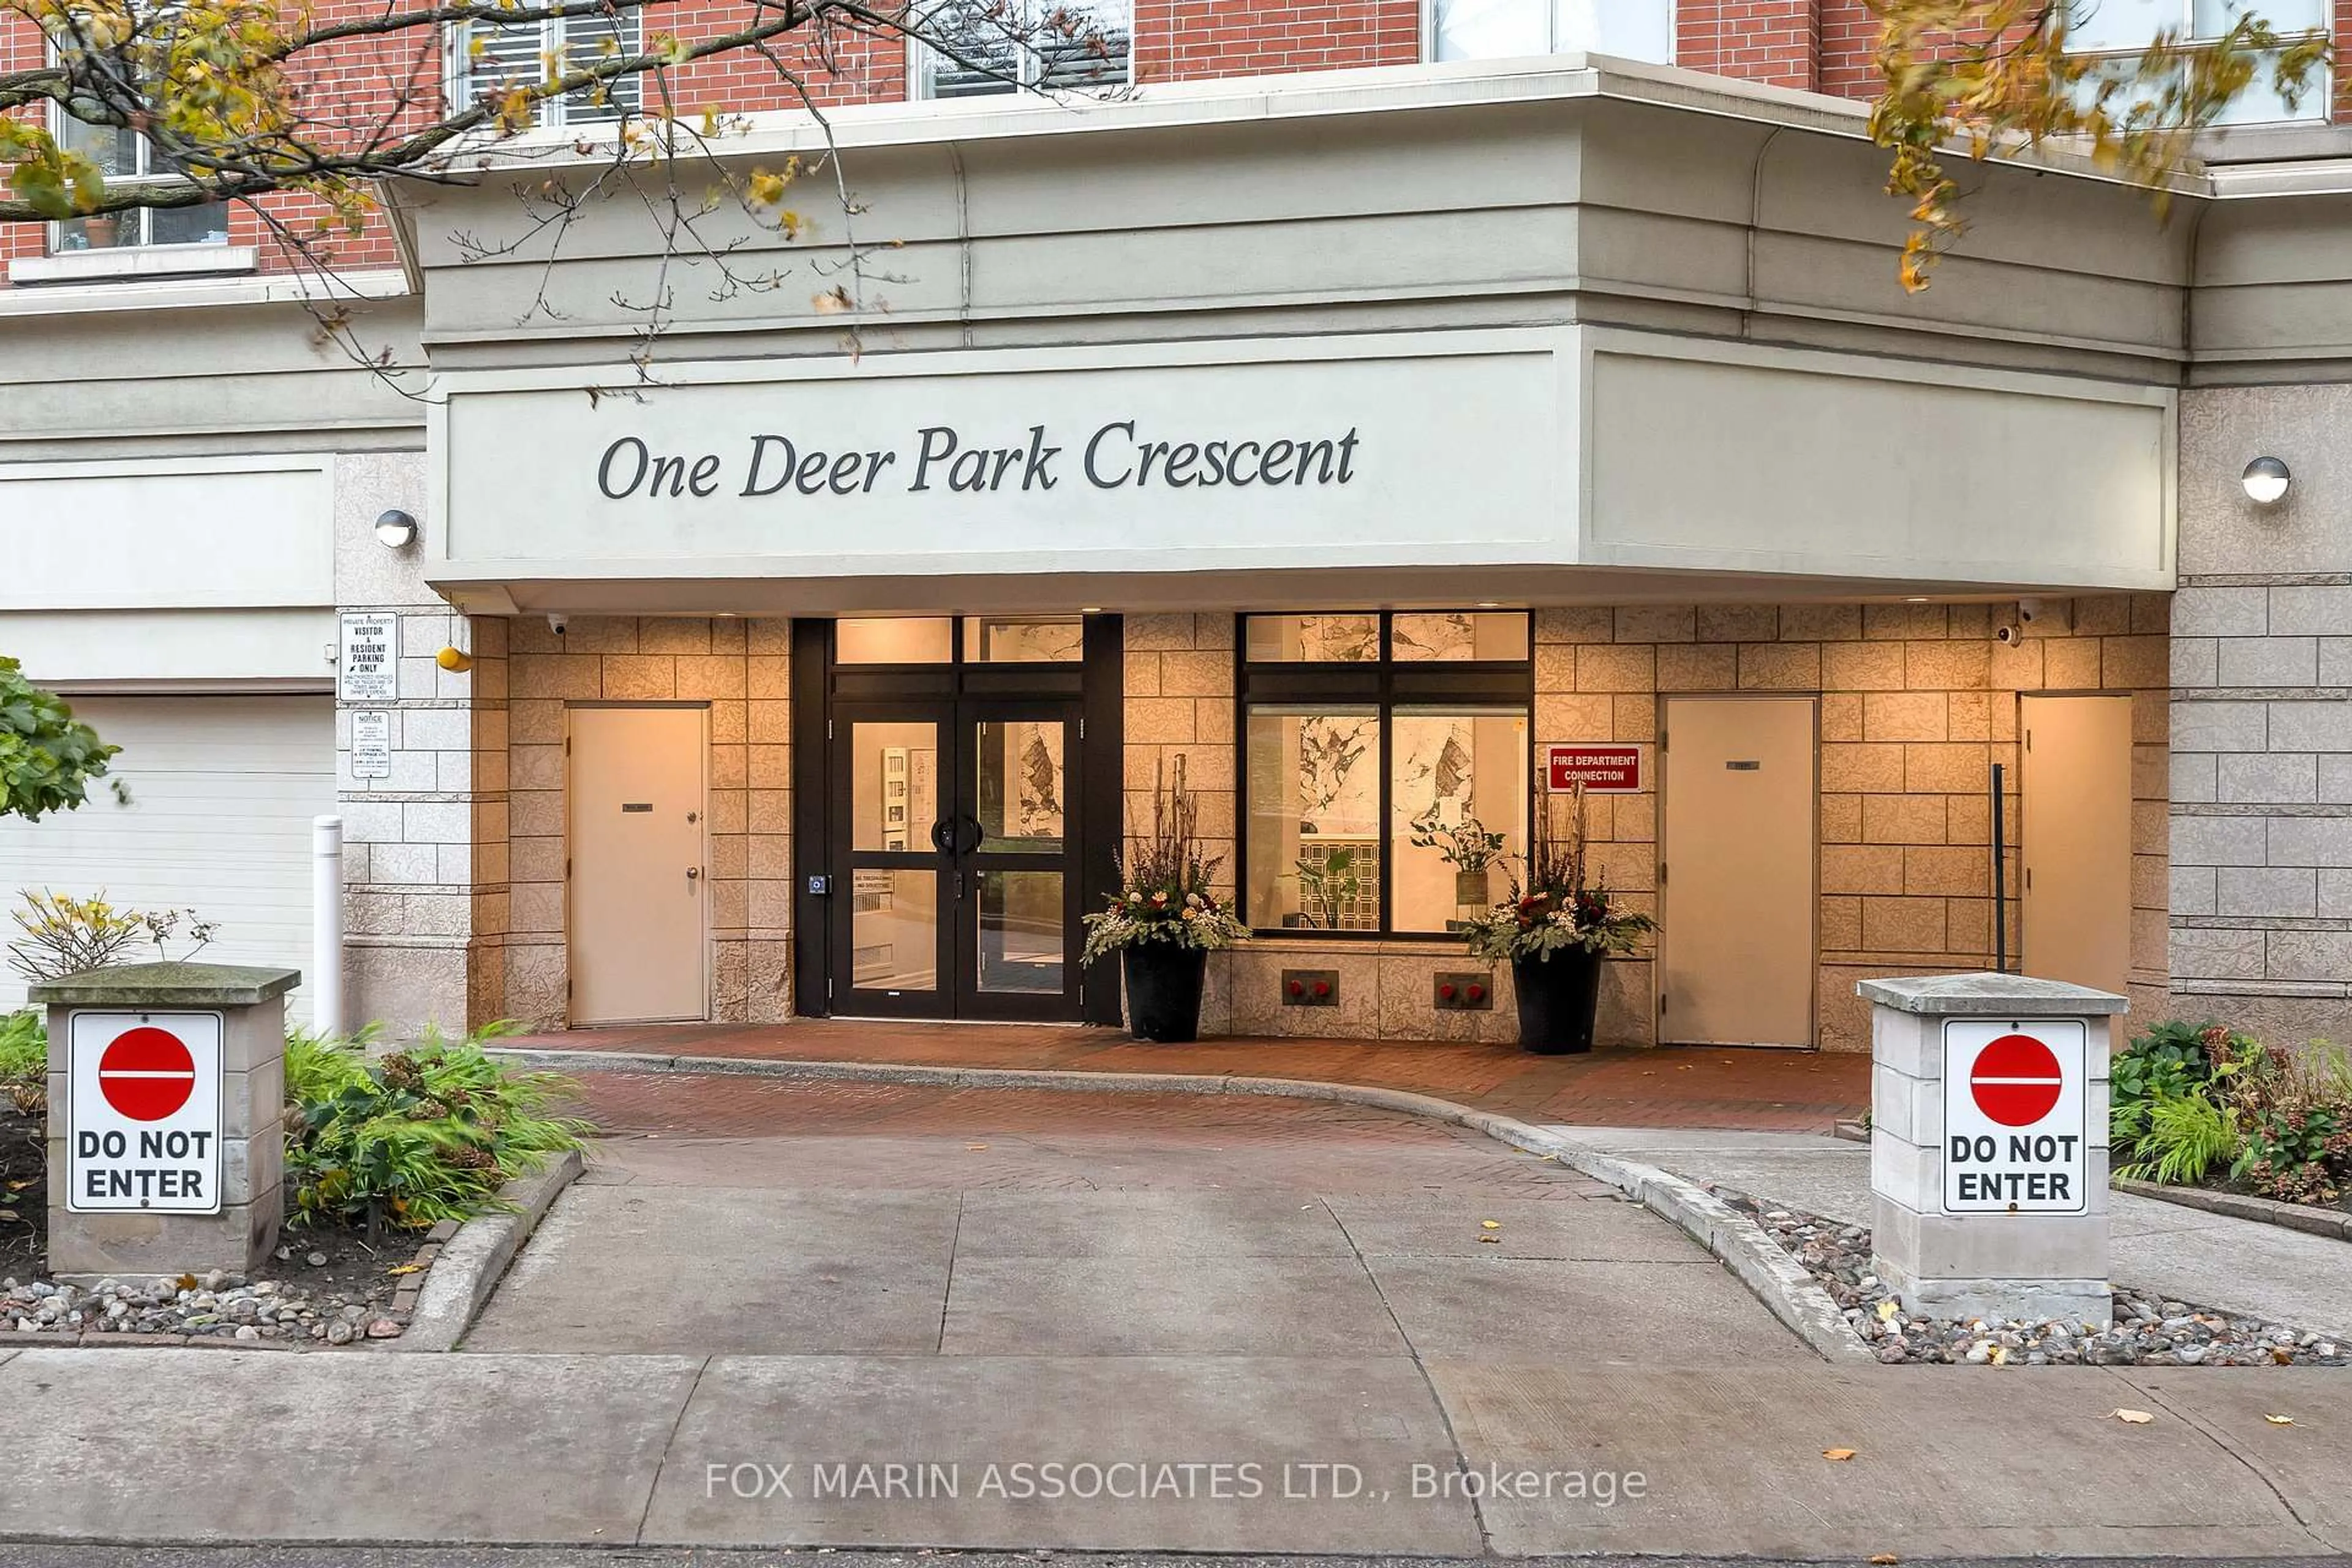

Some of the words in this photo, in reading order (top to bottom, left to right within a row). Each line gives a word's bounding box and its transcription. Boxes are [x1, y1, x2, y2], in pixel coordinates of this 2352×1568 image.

[598, 435, 720, 499] One
[739, 434, 895, 497] Deer
[908, 425, 1061, 491] Park
[1084, 420, 1359, 489] Crescent
[354, 627, 383, 635] VISITOR
[350, 644, 386, 653] RESIDENT
[359, 664, 377, 673] ONLY
[1553, 756, 1574, 766] FIRE
[1575, 756, 1636, 766] DEPARTMENT
[1564, 770, 1624, 781] CONNECTION
[78, 1131, 126, 1159] DO
[140, 1131, 212, 1159] NOT
[1950, 1135, 1997, 1163] DO
[2009, 1135, 2078, 1163] NOT
[86, 1169, 203, 1198] ENTER
[1959, 1173, 2070, 1200] ENTER
